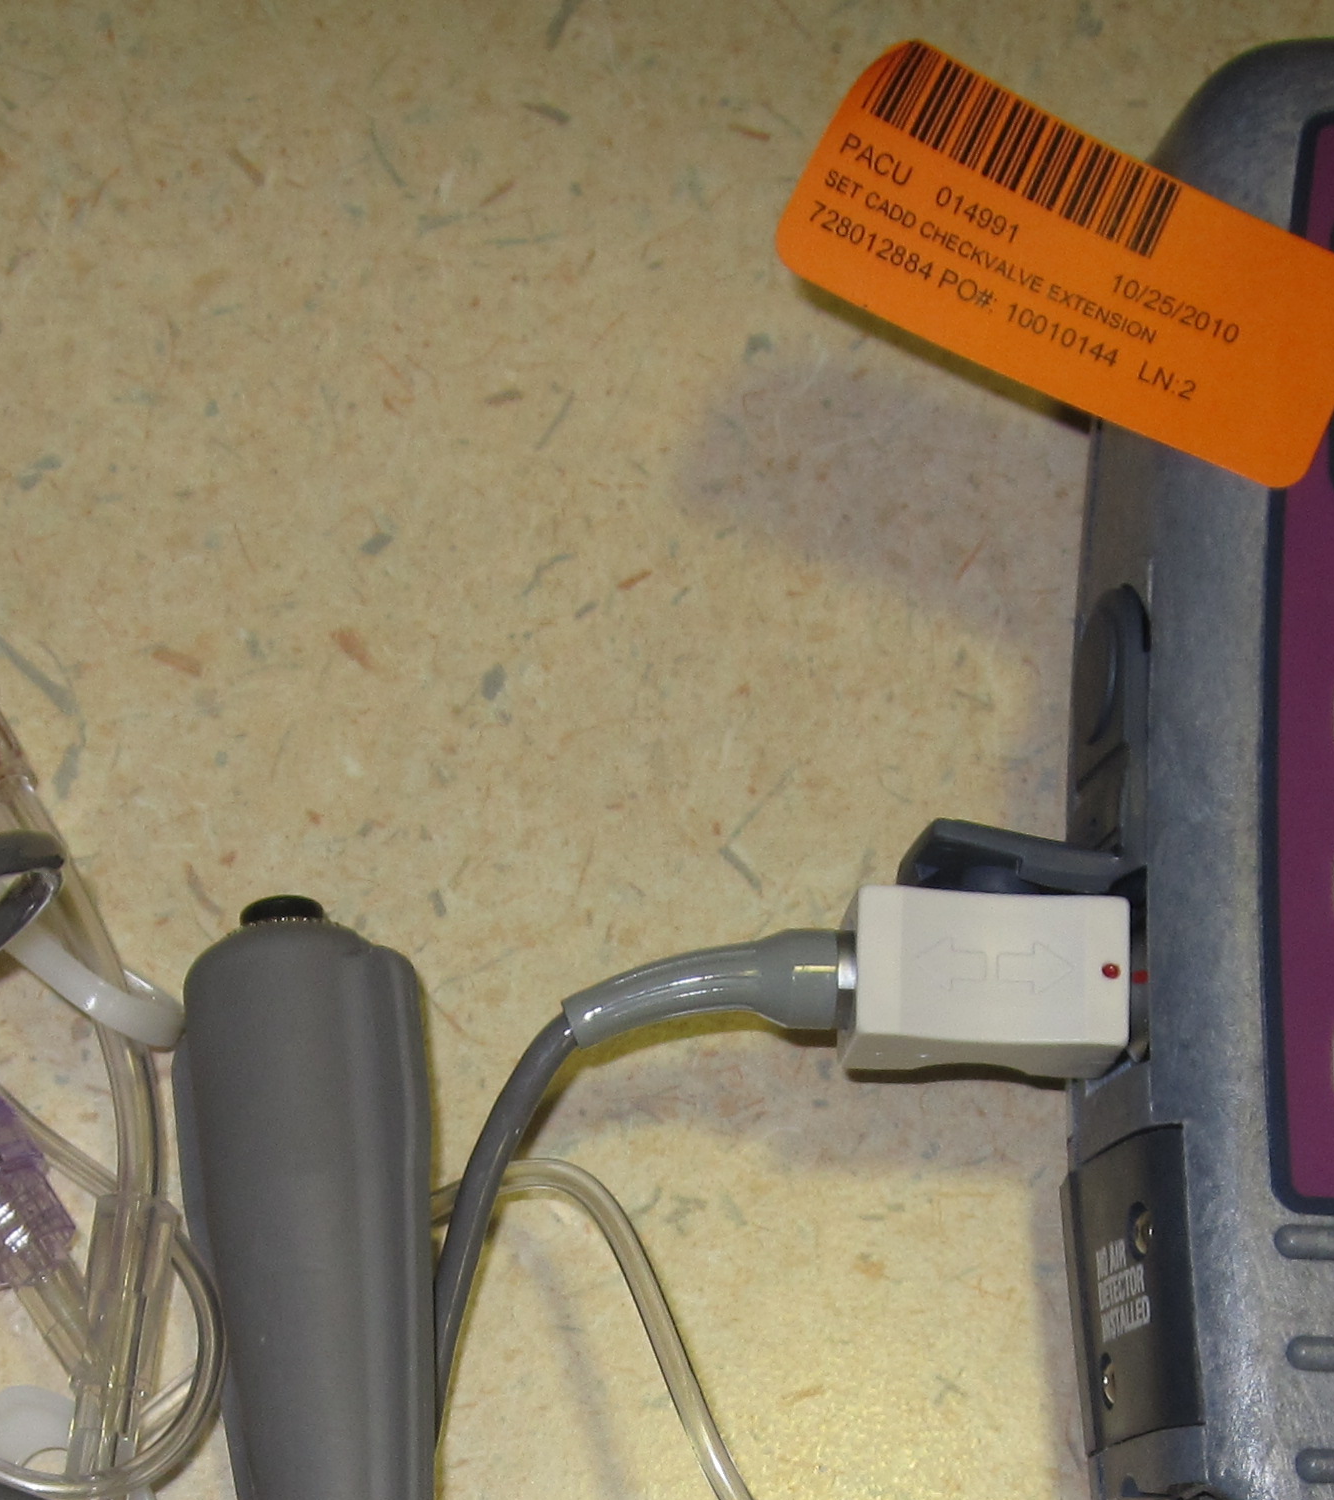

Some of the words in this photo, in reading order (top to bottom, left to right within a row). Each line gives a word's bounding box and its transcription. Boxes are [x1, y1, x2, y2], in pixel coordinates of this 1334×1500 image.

[824, 169, 864, 199] SET
[865, 192, 916, 229] CADD
[919, 220, 1044, 293] CHECKVALVE
[1047, 283, 1156, 344] EXTENSION
[839, 133, 913, 186] PACU
[935, 185, 1020, 244] 014991
[809, 200, 934, 281] 728012884
[937, 268, 997, 315] PO#:
[1007, 302, 1119, 368] 10010144
[1137, 360, 1197, 401] LN:2
[1112, 274, 1240, 344] 10/25/2010
